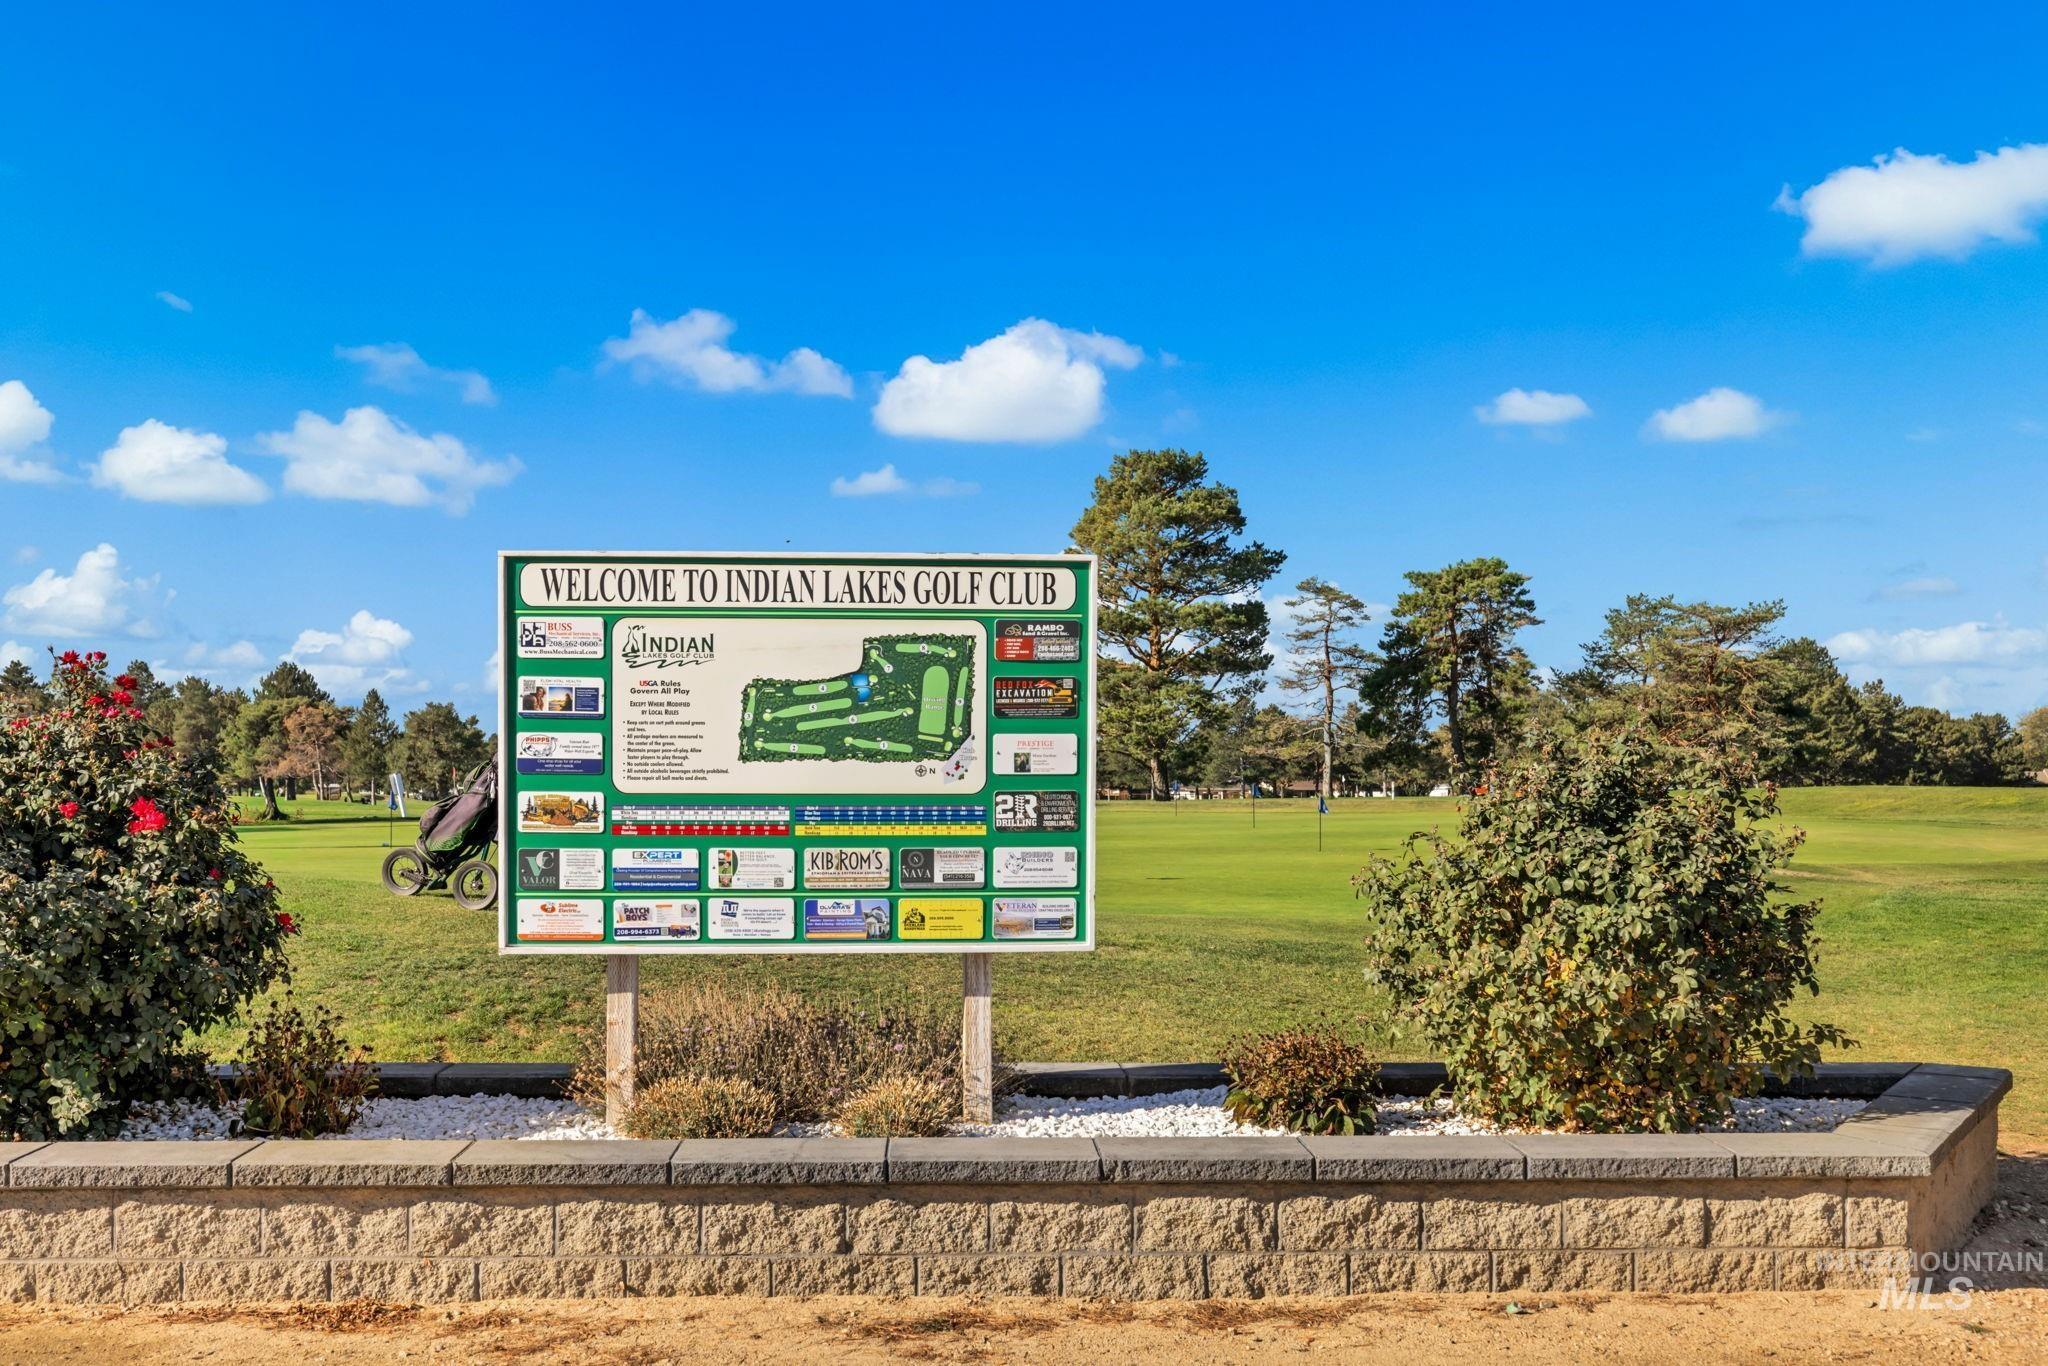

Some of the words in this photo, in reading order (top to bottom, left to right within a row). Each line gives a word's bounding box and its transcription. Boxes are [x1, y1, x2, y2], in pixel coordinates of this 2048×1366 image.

[541, 568, 677, 603] WELCOME
[683, 568, 718, 604] TO
[725, 568, 816, 604] INDIAN
[823, 569, 906, 605] LAKES
[913, 570, 982, 605] GOLF
[989, 571, 1056, 606] CLUB
[547, 622, 572, 631] BUSS
[642, 632, 714, 653] INDIAN
[630, 687, 658, 695] Govern
[660, 687, 671, 695] All
[673, 687, 690, 695] Play
[996, 689, 1054, 697] EXCAVATION
[632, 851, 682, 859] EXPERT
[902, 869, 931, 878] NAVA
[522, 876, 556, 884] VALOR
[995, 903, 1037, 911] VETERAN
